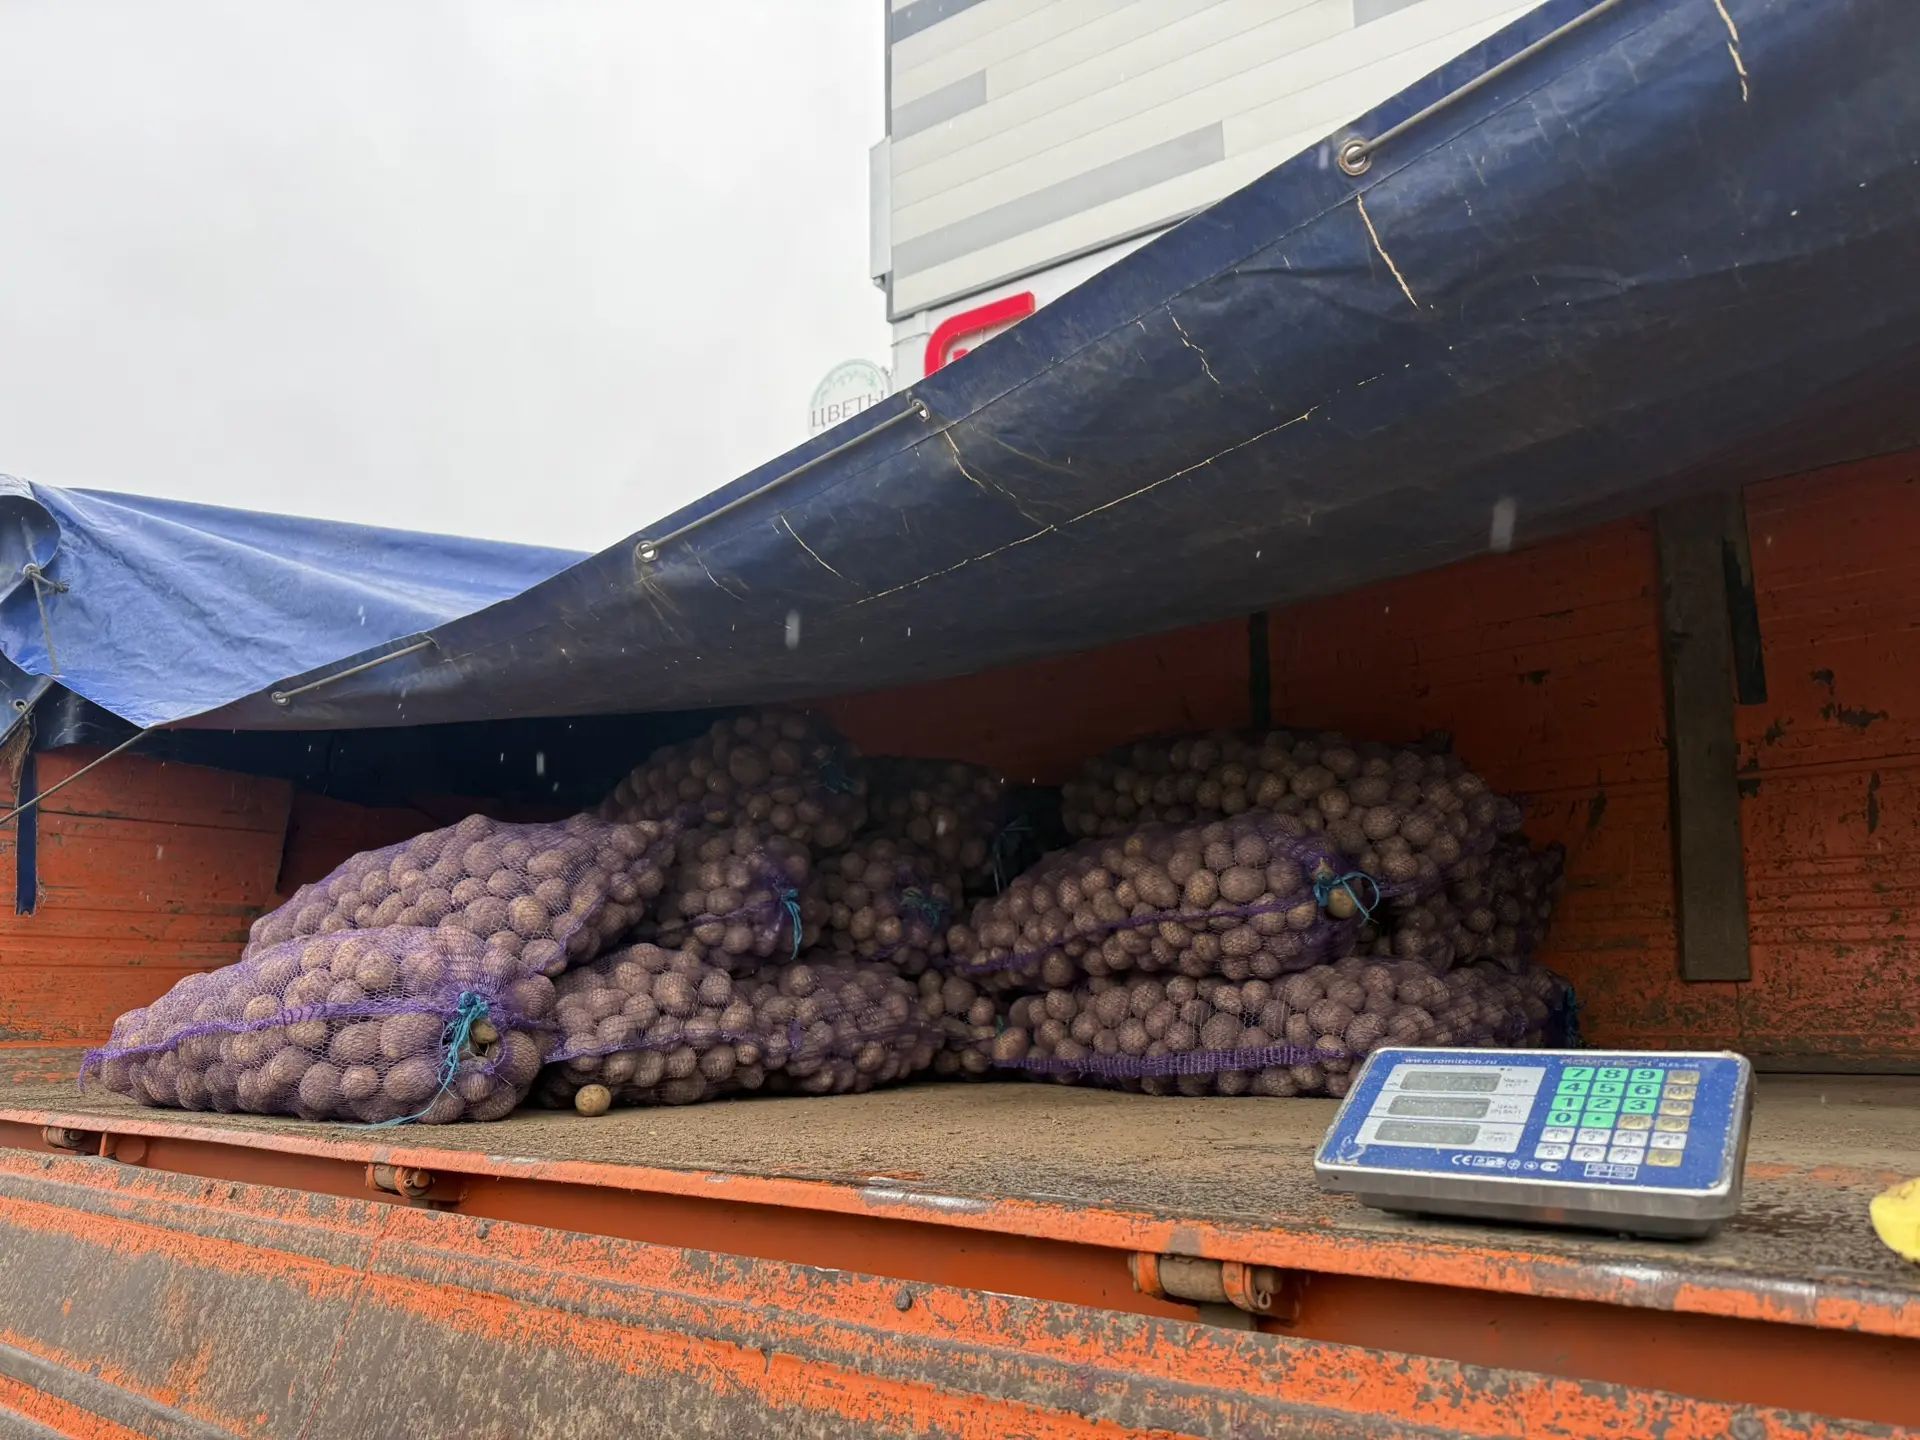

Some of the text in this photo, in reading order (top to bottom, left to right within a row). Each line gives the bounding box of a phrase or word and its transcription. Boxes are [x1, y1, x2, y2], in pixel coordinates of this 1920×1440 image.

[1572, 1068, 1656, 1080] 7 8 9
[1564, 1082, 1651, 1095] 4 5 6
[1565, 1097, 1647, 1110] 1 2 3
[1555, 1112, 1571, 1123] 0
